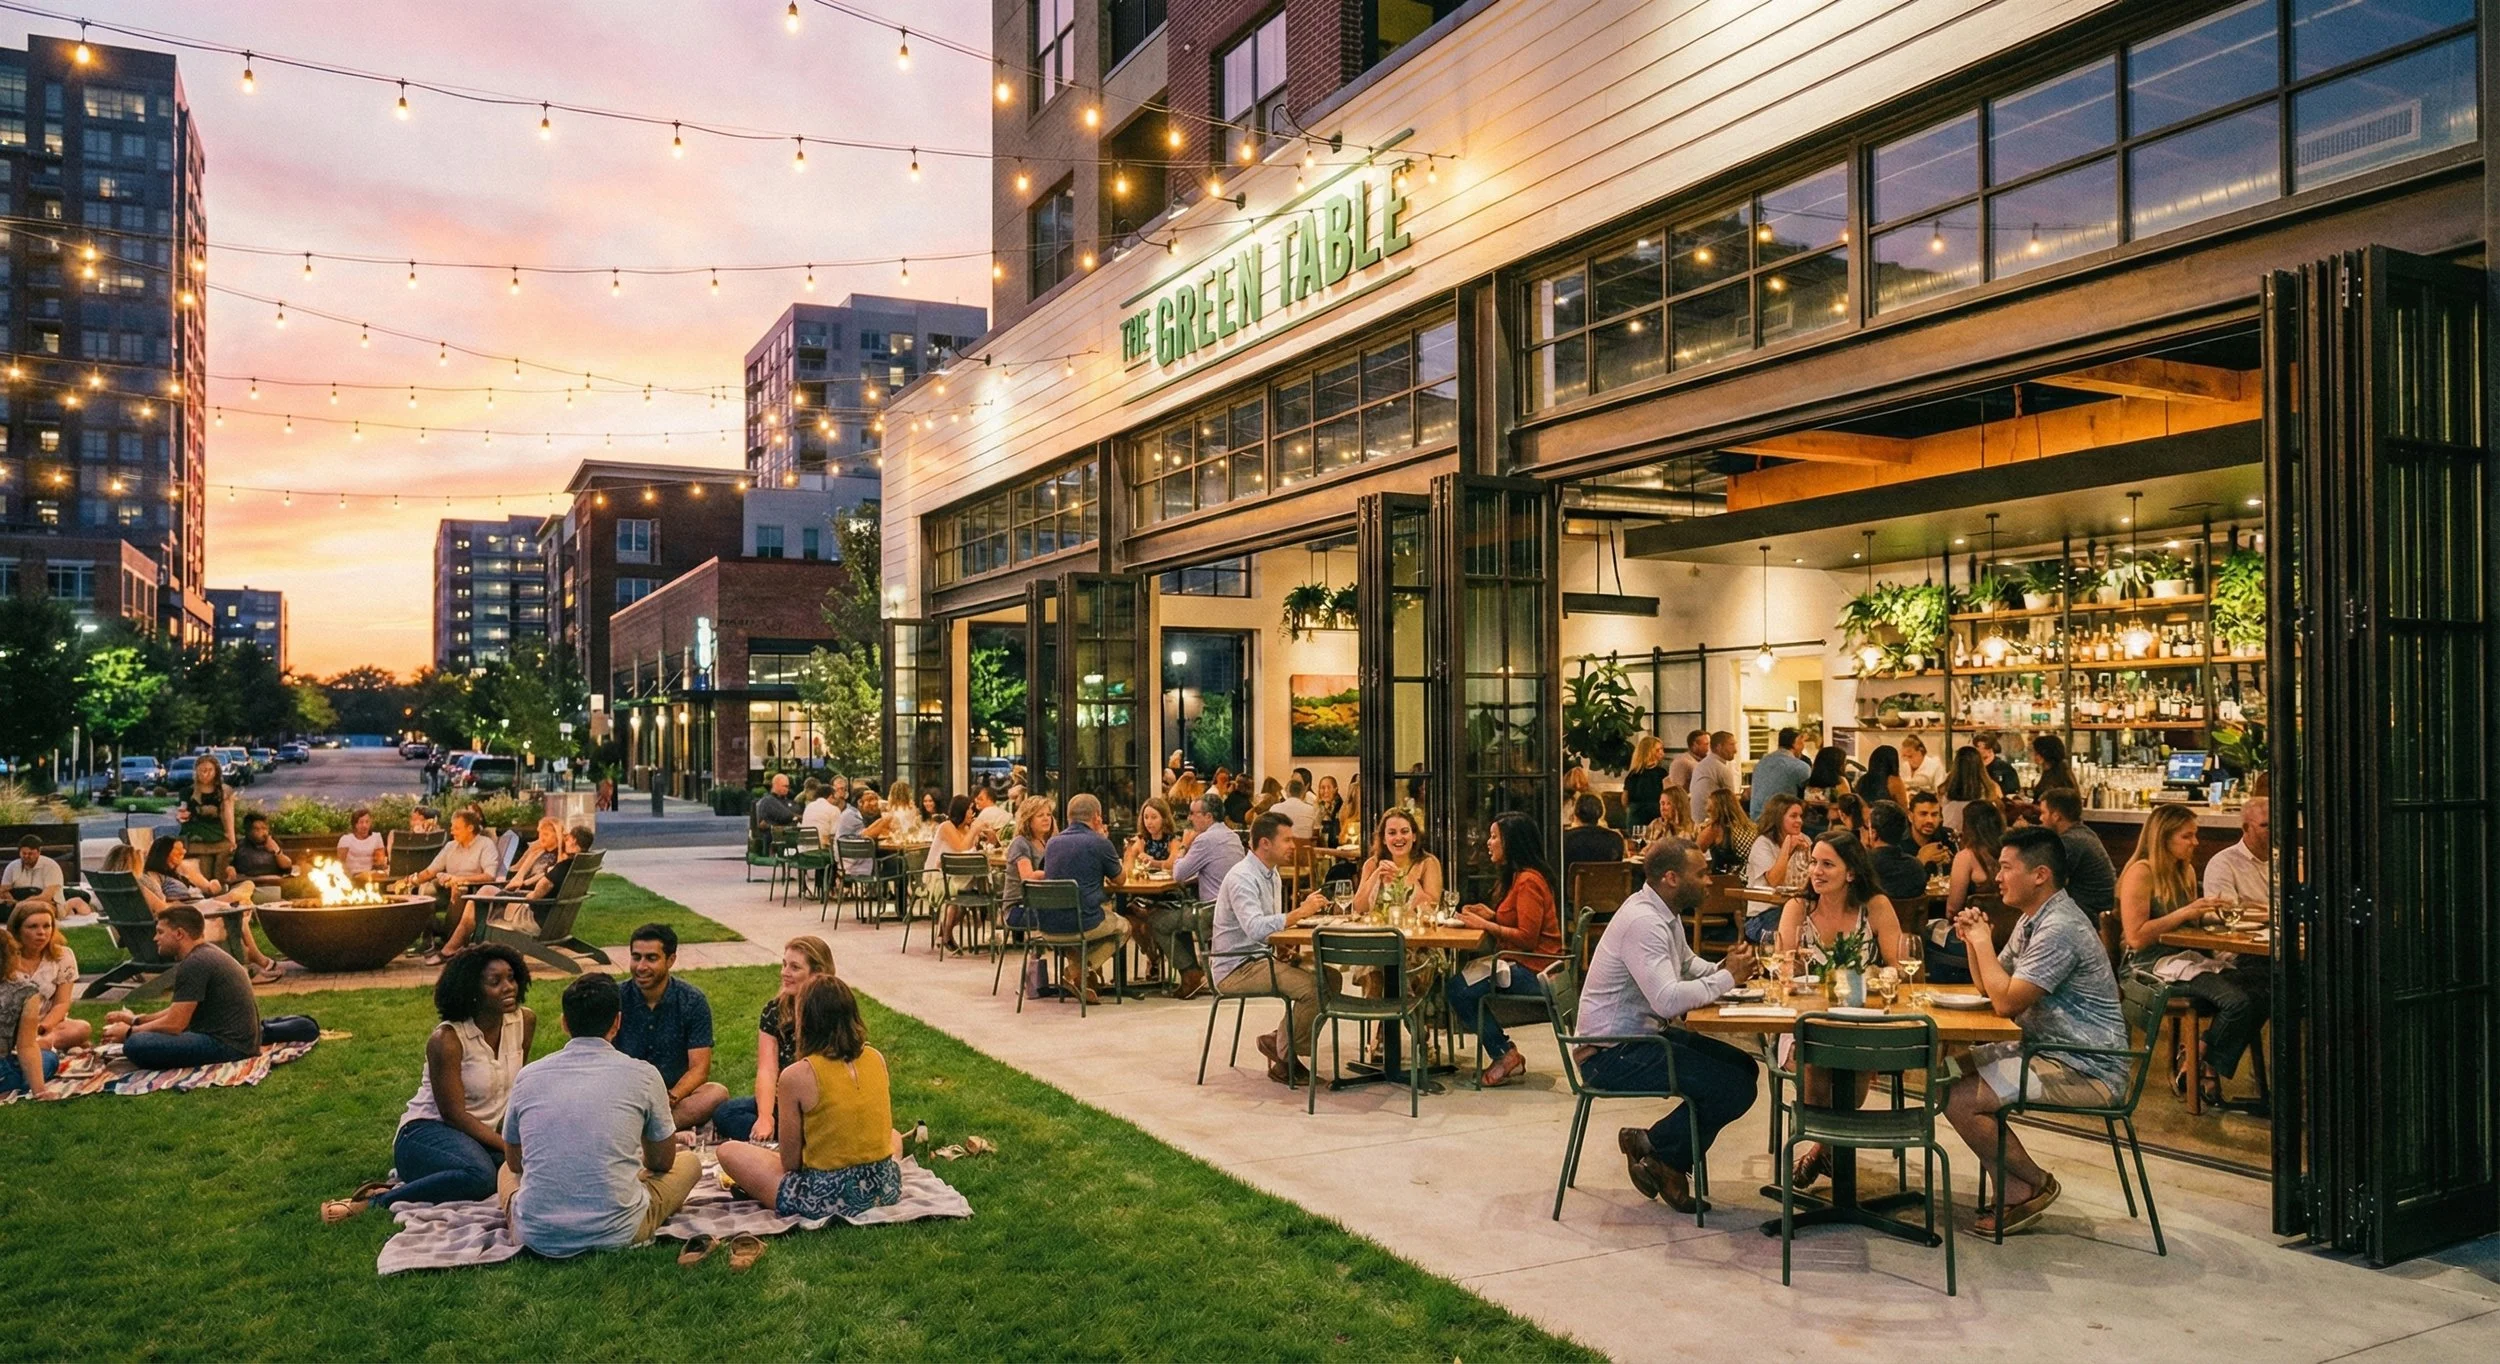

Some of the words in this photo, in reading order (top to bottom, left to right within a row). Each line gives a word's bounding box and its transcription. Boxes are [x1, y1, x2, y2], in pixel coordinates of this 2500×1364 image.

[1120, 308, 1151, 362] THE
[1156, 243, 1262, 367] GREEN
[1272, 164, 1411, 308] TABLE
